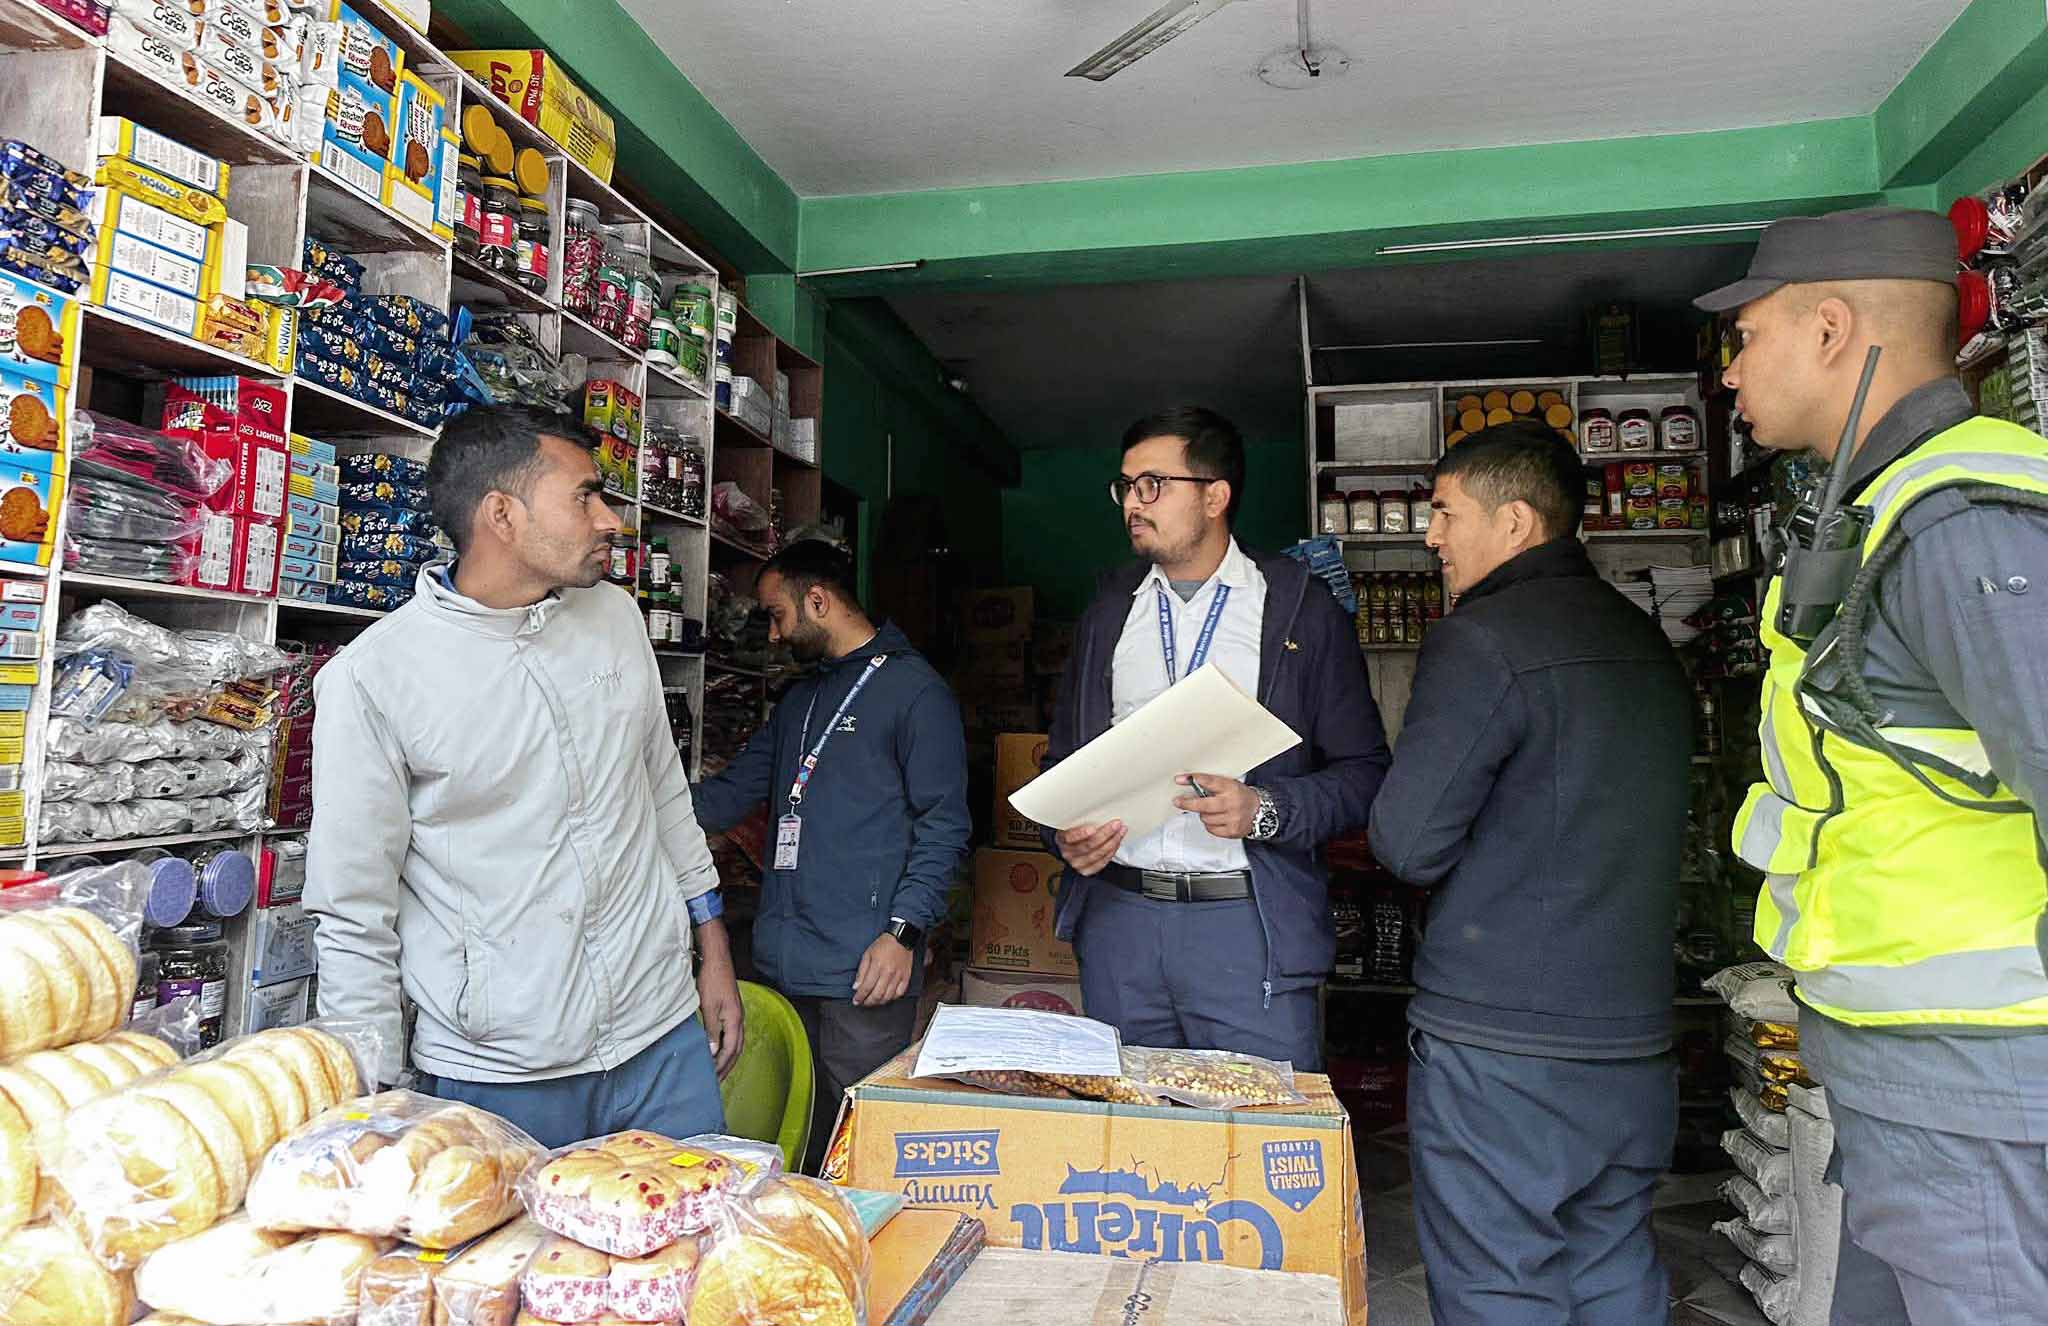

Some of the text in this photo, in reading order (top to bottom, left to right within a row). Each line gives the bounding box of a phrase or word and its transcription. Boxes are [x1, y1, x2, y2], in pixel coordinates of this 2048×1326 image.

[153, 6, 188, 33] Crunch
[220, 12, 252, 39] Crunch
[142, 37, 176, 65] Crunch
[224, 48, 254, 74] Crunch
[206, 81, 237, 107] Crunch
[255, 429, 284, 444] LIGHTER
[239, 442, 249, 485] LIGHTER
[903, 1140, 991, 1166] Sticks
[1266, 1141, 1315, 1153] FLAVOUR
[1269, 1155, 1319, 1174] TWIST
[902, 1179, 999, 1210] Yummy
[1270, 1172, 1321, 1191] MASALA
[1010, 1199, 1284, 1271] Current
